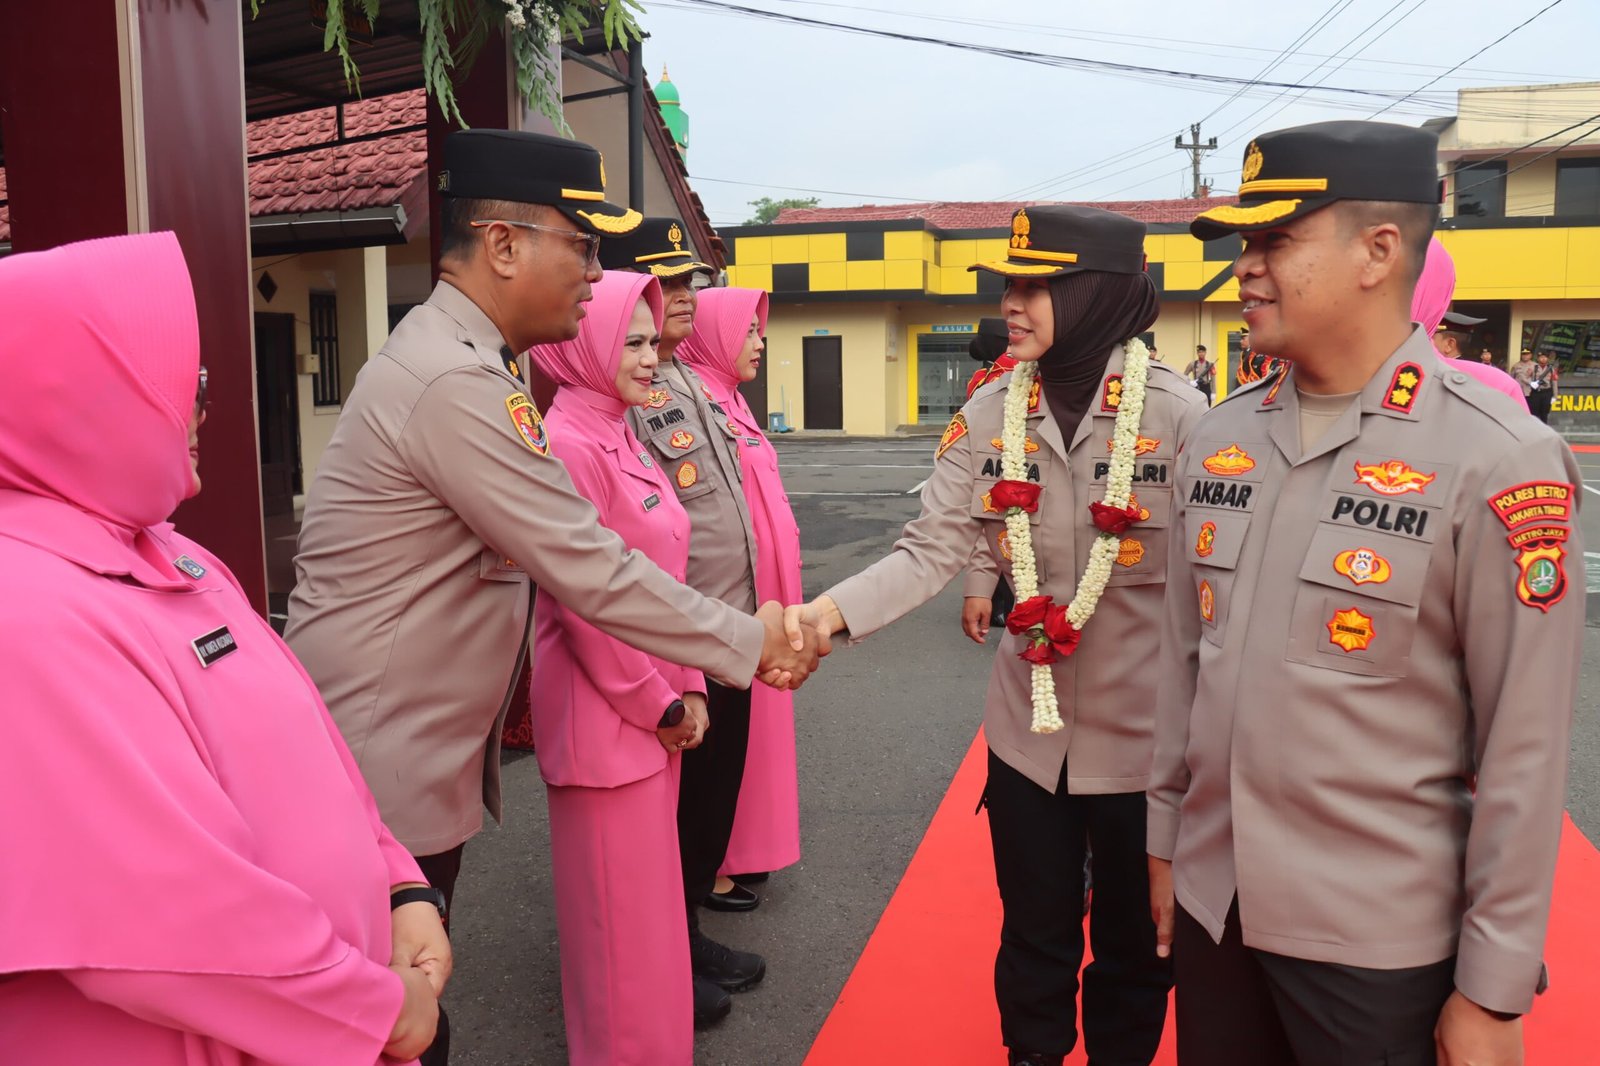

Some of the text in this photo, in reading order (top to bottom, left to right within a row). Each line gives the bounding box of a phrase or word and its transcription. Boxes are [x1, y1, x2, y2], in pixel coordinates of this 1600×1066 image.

[662, 408, 685, 426] ARYO
[1094, 462, 1167, 483] PLRI
[1189, 479, 1253, 509] AKBAR
[1495, 486, 1567, 511] POLRES METRO
[1331, 495, 1429, 537] POLRI
[1508, 508, 1543, 525] JAKARTA
